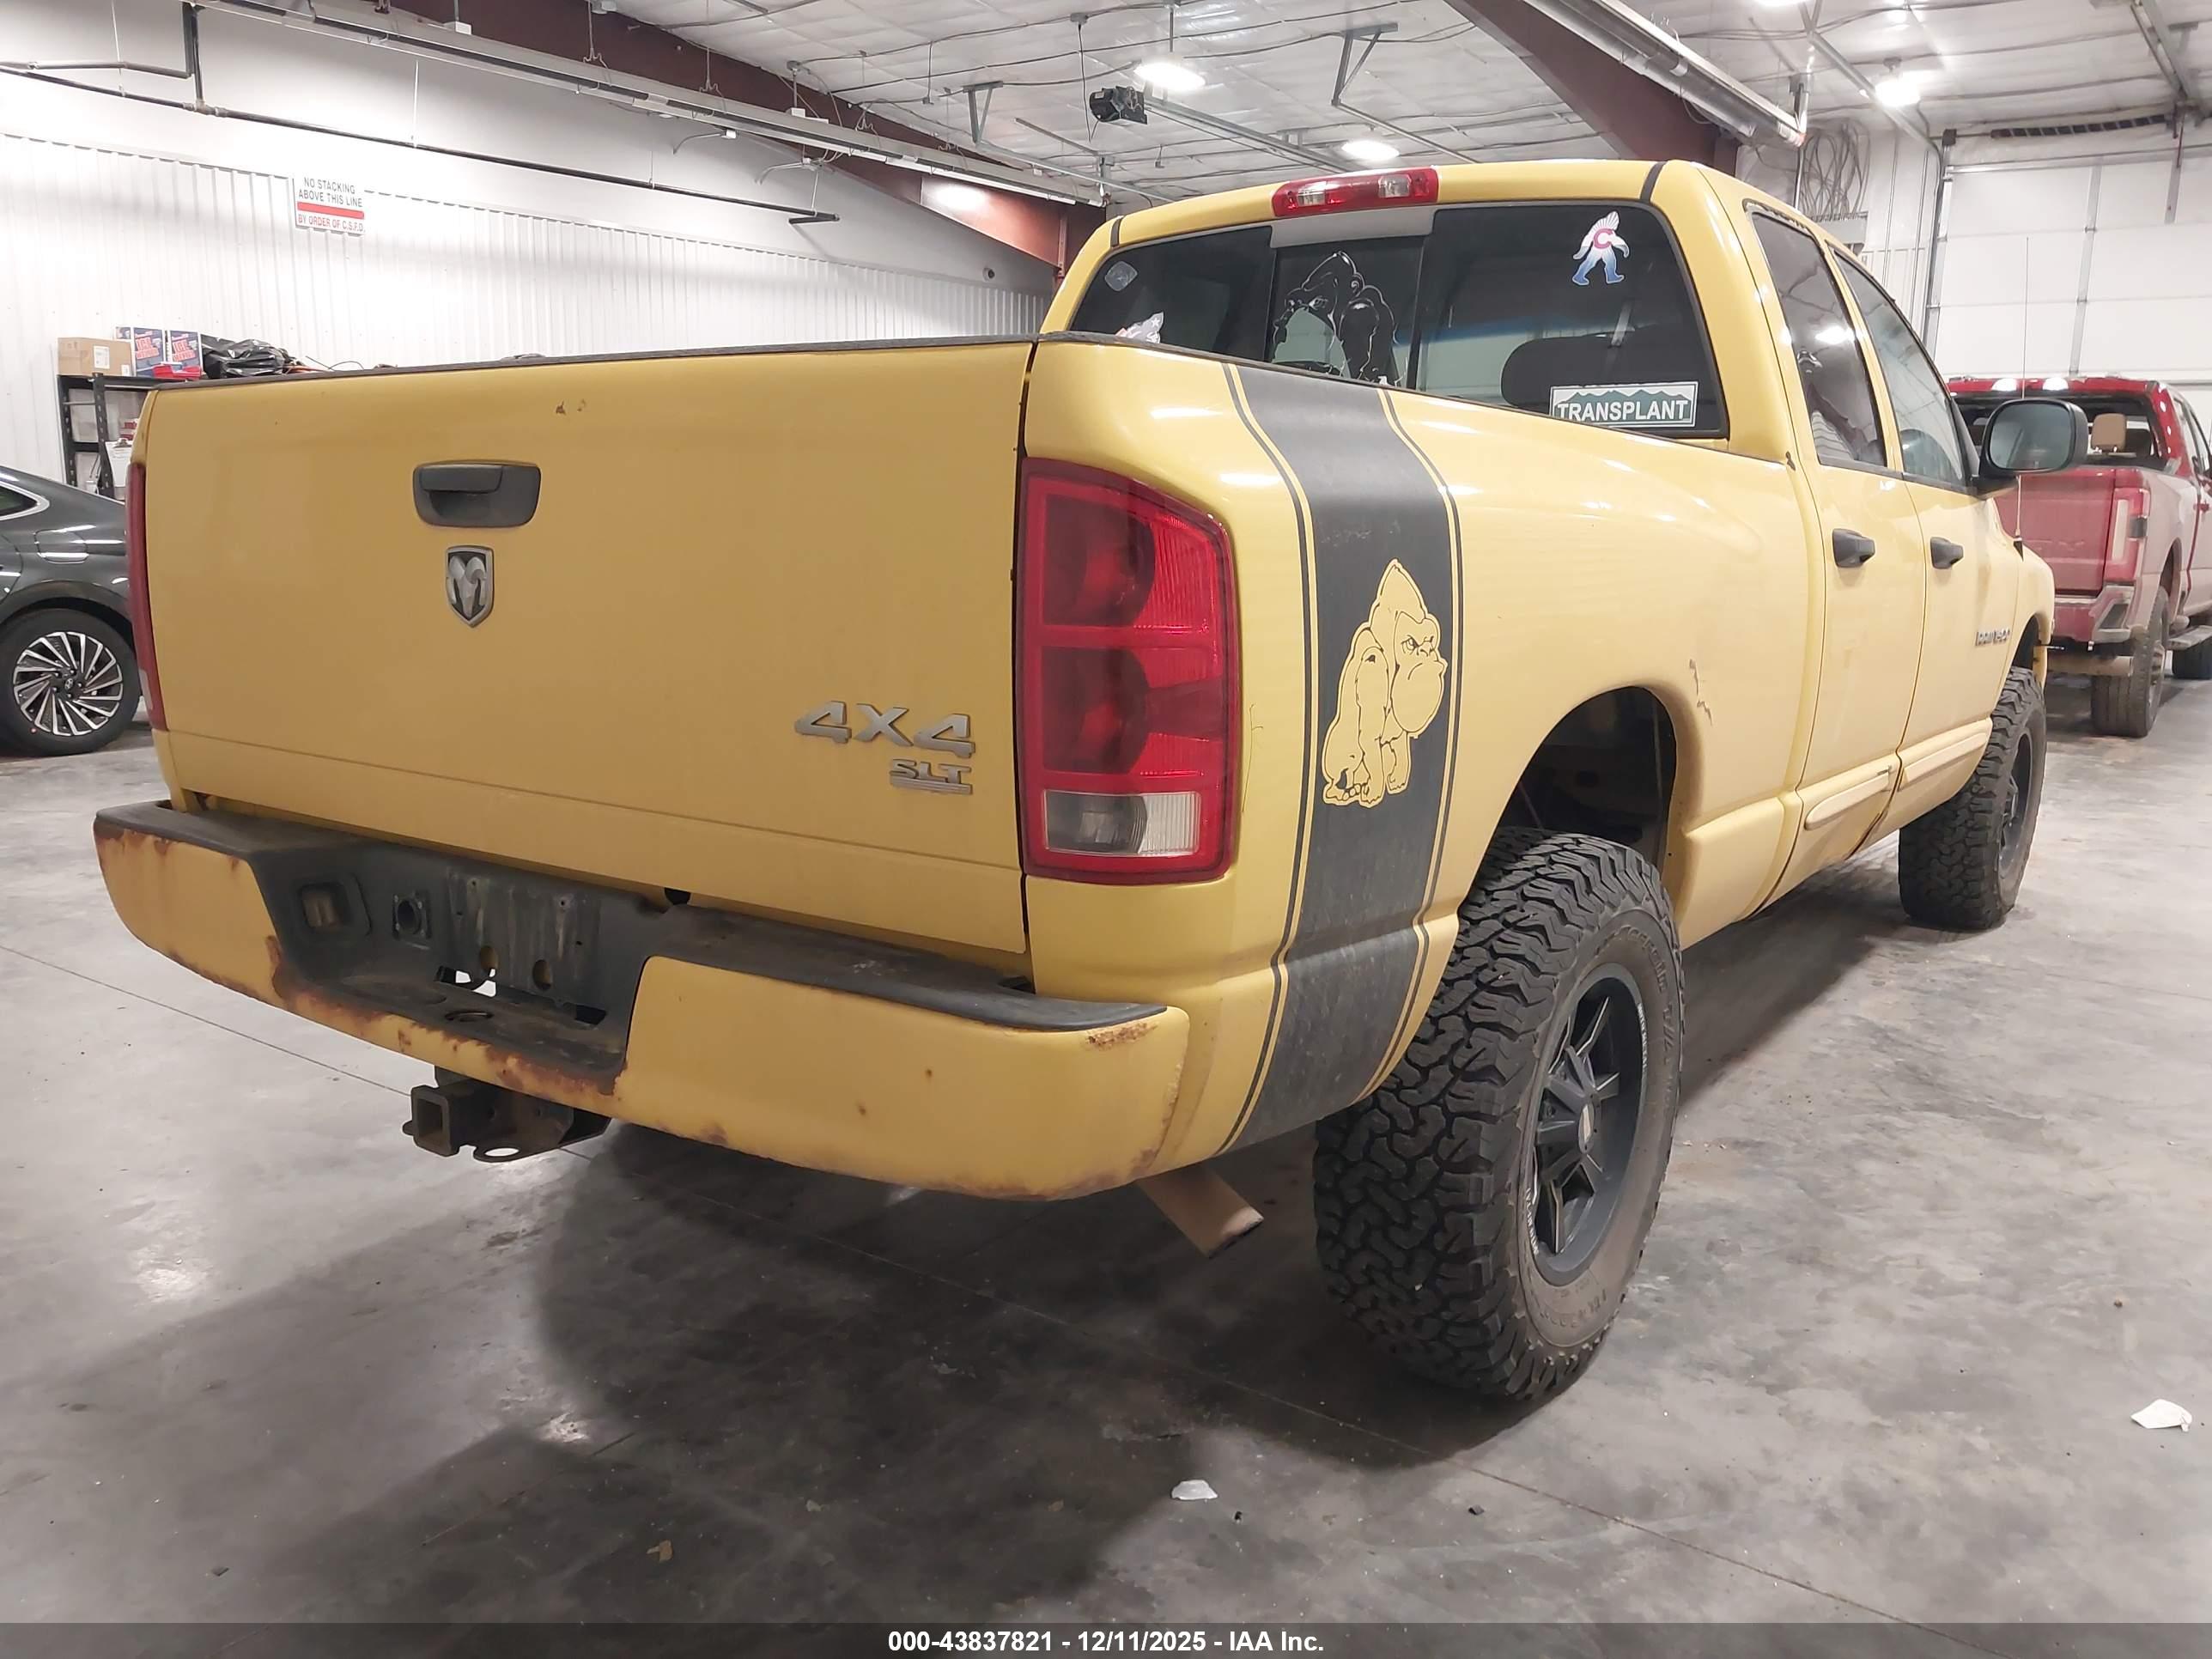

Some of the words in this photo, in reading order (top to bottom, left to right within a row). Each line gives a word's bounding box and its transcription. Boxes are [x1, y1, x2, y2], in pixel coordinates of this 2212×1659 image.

[304, 177, 315, 188] NO
[318, 179, 356, 194] STACKING
[298, 189, 325, 202] ABOVE
[327, 193, 343, 205] THIS
[346, 197, 363, 208] LINE
[298, 214, 307, 223] BY
[309, 216, 331, 228] ORDER
[332, 219, 341, 229] OF
[1594, 228, 1613, 249] C
[1557, 399, 1688, 422] TRANSPLANT
[794, 700, 976, 759] 4X4
[889, 759, 972, 785] SLT
